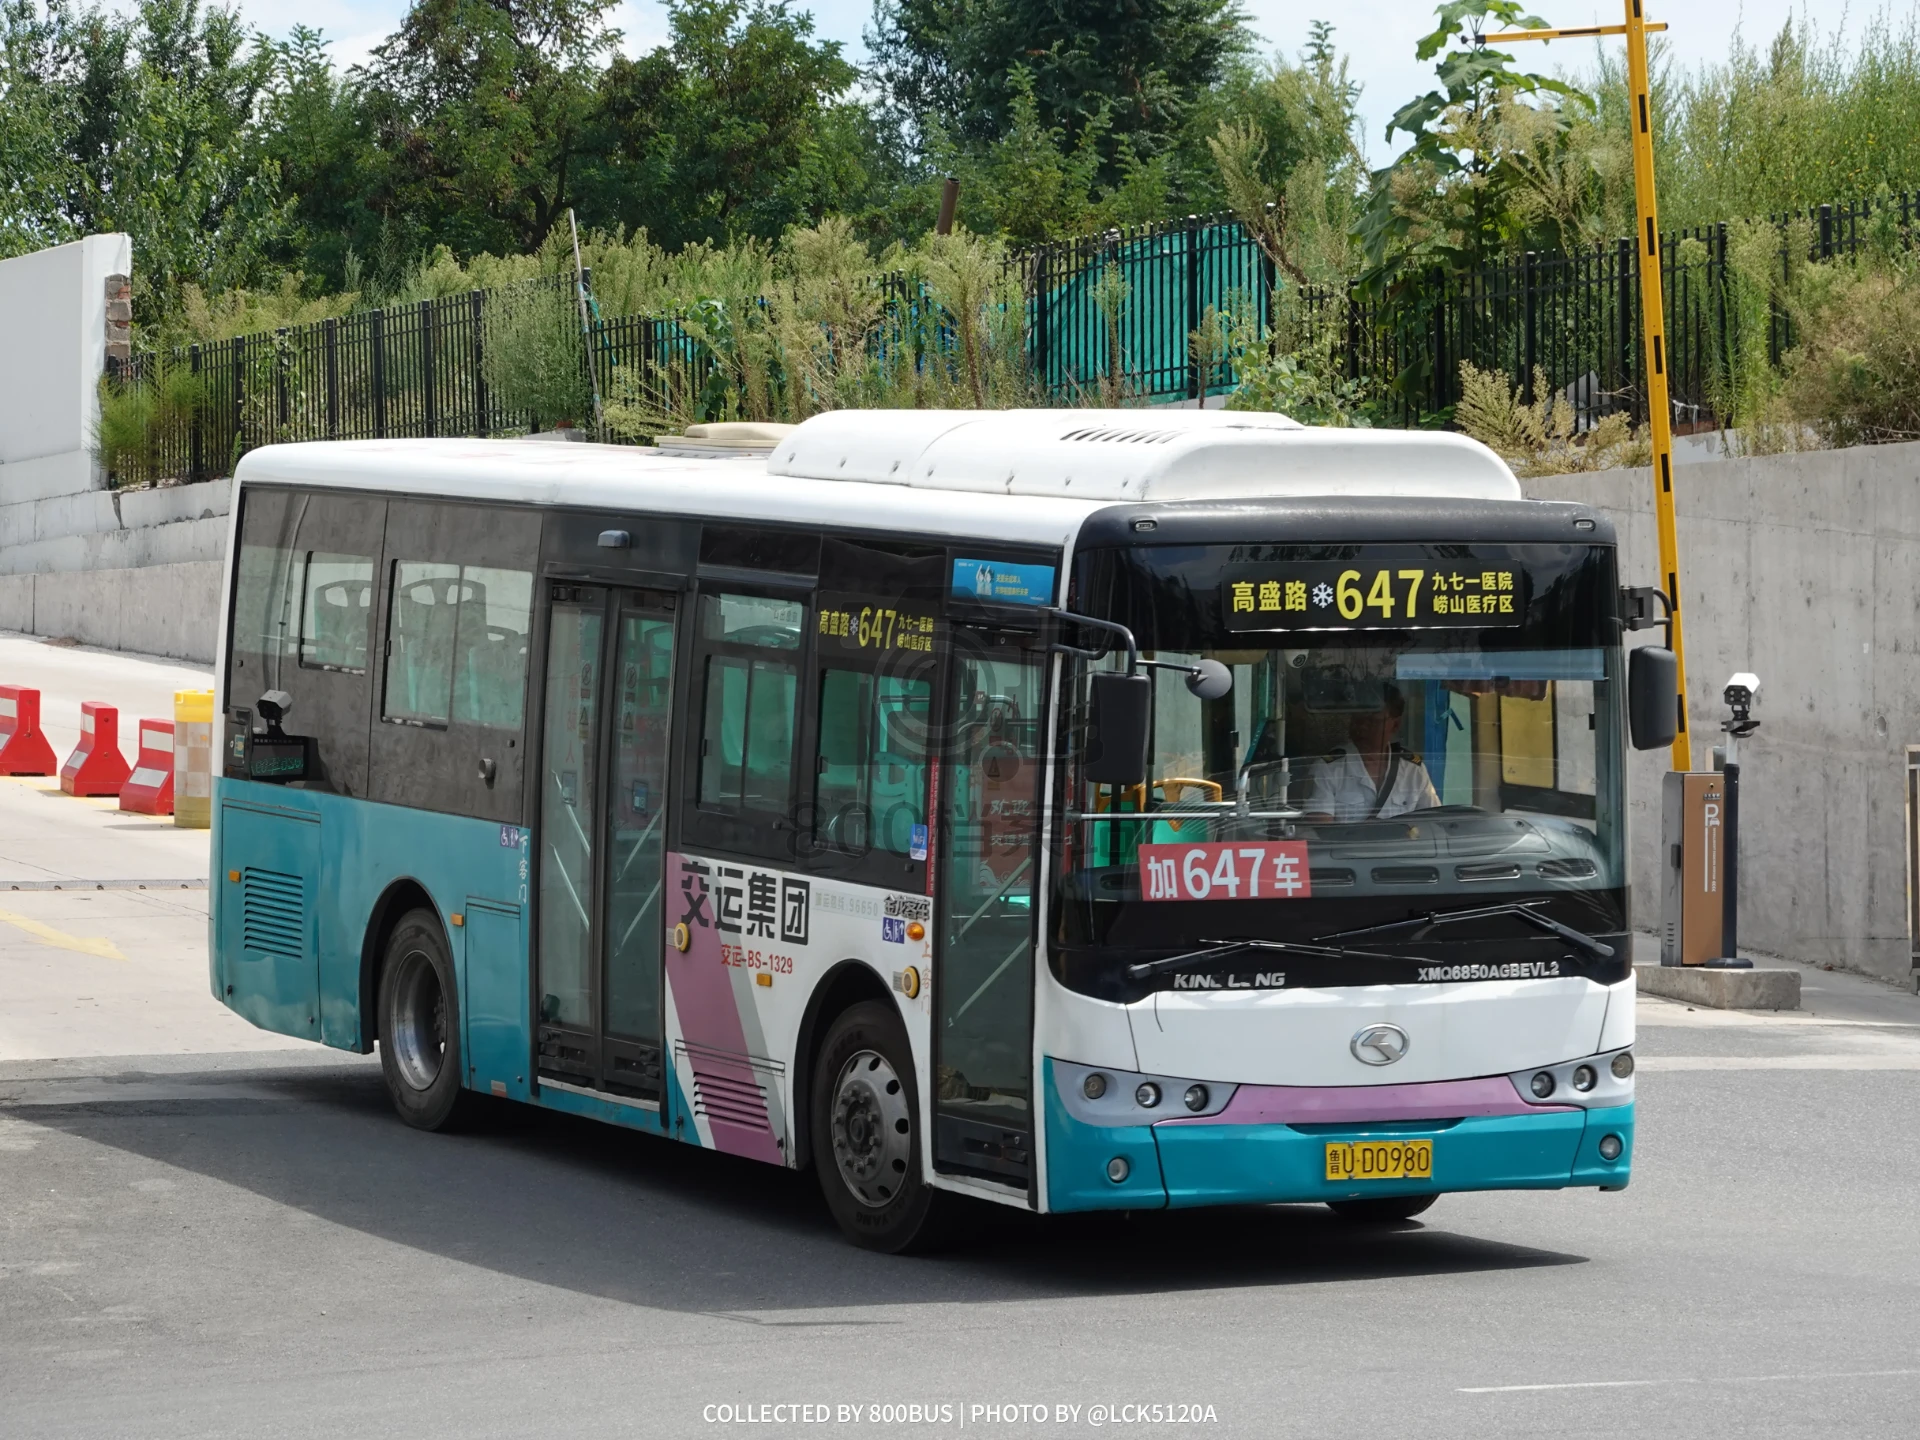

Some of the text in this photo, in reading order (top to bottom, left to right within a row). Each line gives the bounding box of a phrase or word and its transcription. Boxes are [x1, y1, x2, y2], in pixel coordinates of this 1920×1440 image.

[1231, 569, 1425, 620] 高盛路 647
[1431, 571, 1514, 591] 九七一医院
[1432, 594, 1515, 614] 崂山医疗区
[819, 606, 897, 649] 高盛路 647
[898, 613, 934, 633] 九七一医院
[1147, 848, 1303, 899] 加647车
[681, 861, 810, 946] 交运集团
[721, 943, 793, 974] 交运-BS-1329
[1417, 960, 1560, 982] XMQ6850AGBEVL2
